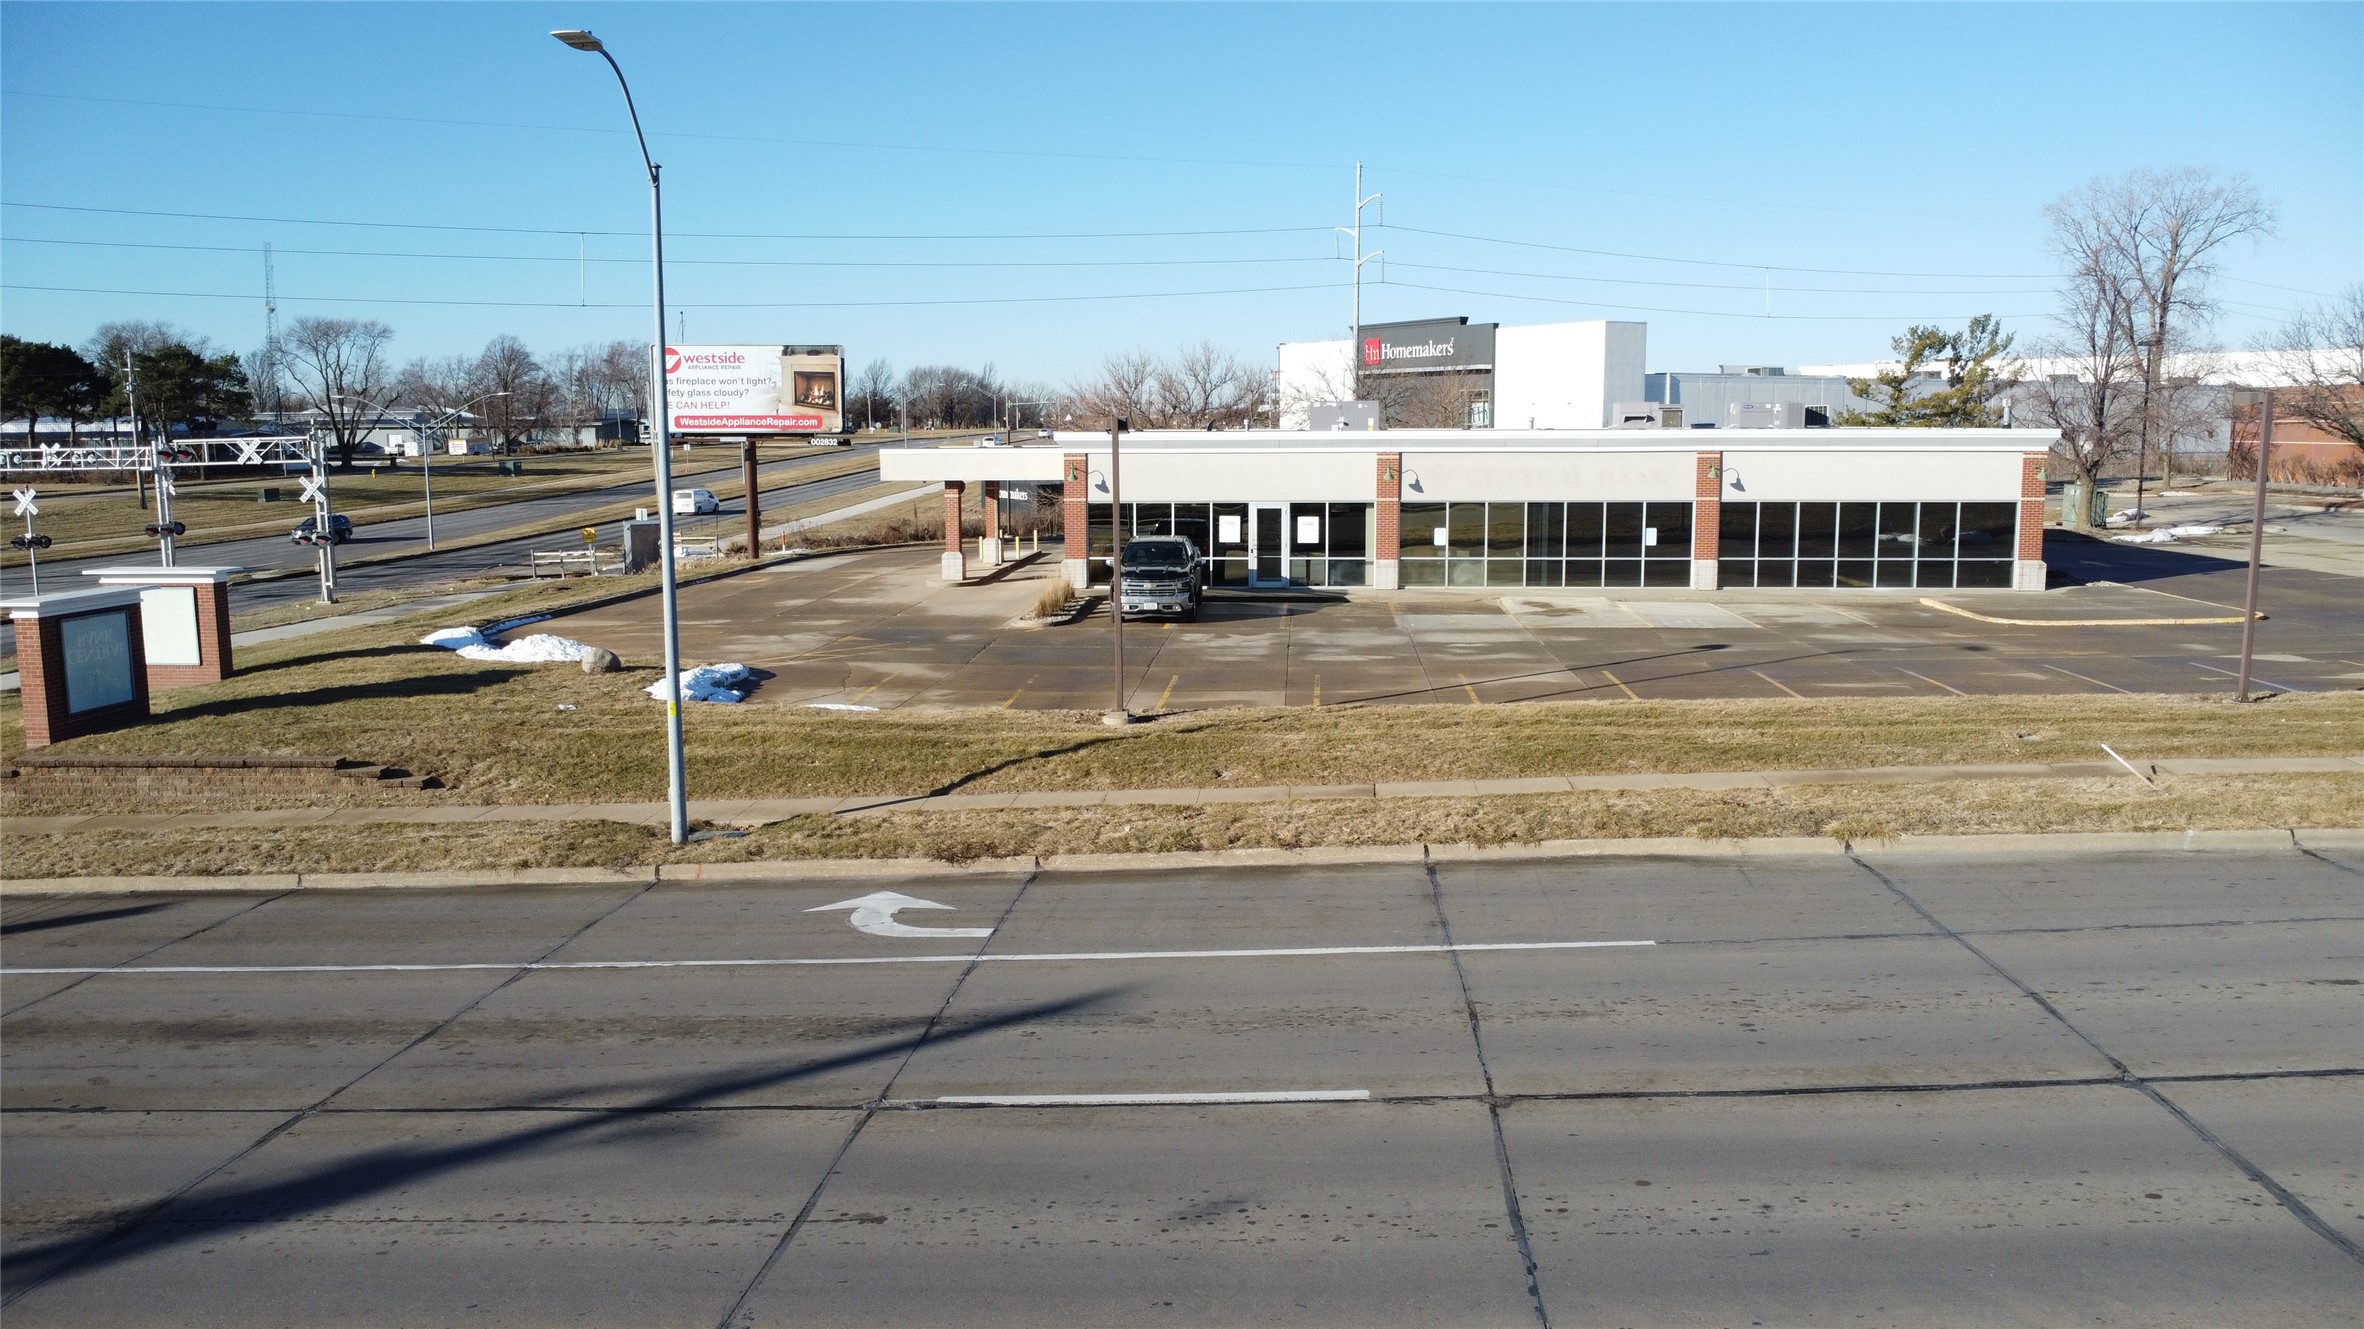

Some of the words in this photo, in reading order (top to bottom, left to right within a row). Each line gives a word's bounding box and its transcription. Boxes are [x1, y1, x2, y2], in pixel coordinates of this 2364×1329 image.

[683, 352, 746, 364] westside
[676, 377, 717, 387] fireplace
[719, 377, 745, 385] won't
[746, 377, 772, 387] light?
[687, 389, 711, 398] glass
[713, 389, 750, 398] cloudy?
[676, 401, 698, 409] CAN
[700, 401, 730, 409] HELP!
[680, 417, 818, 427] WestsideApplianceRepair.com
[810, 438, 838, 446] 002832
